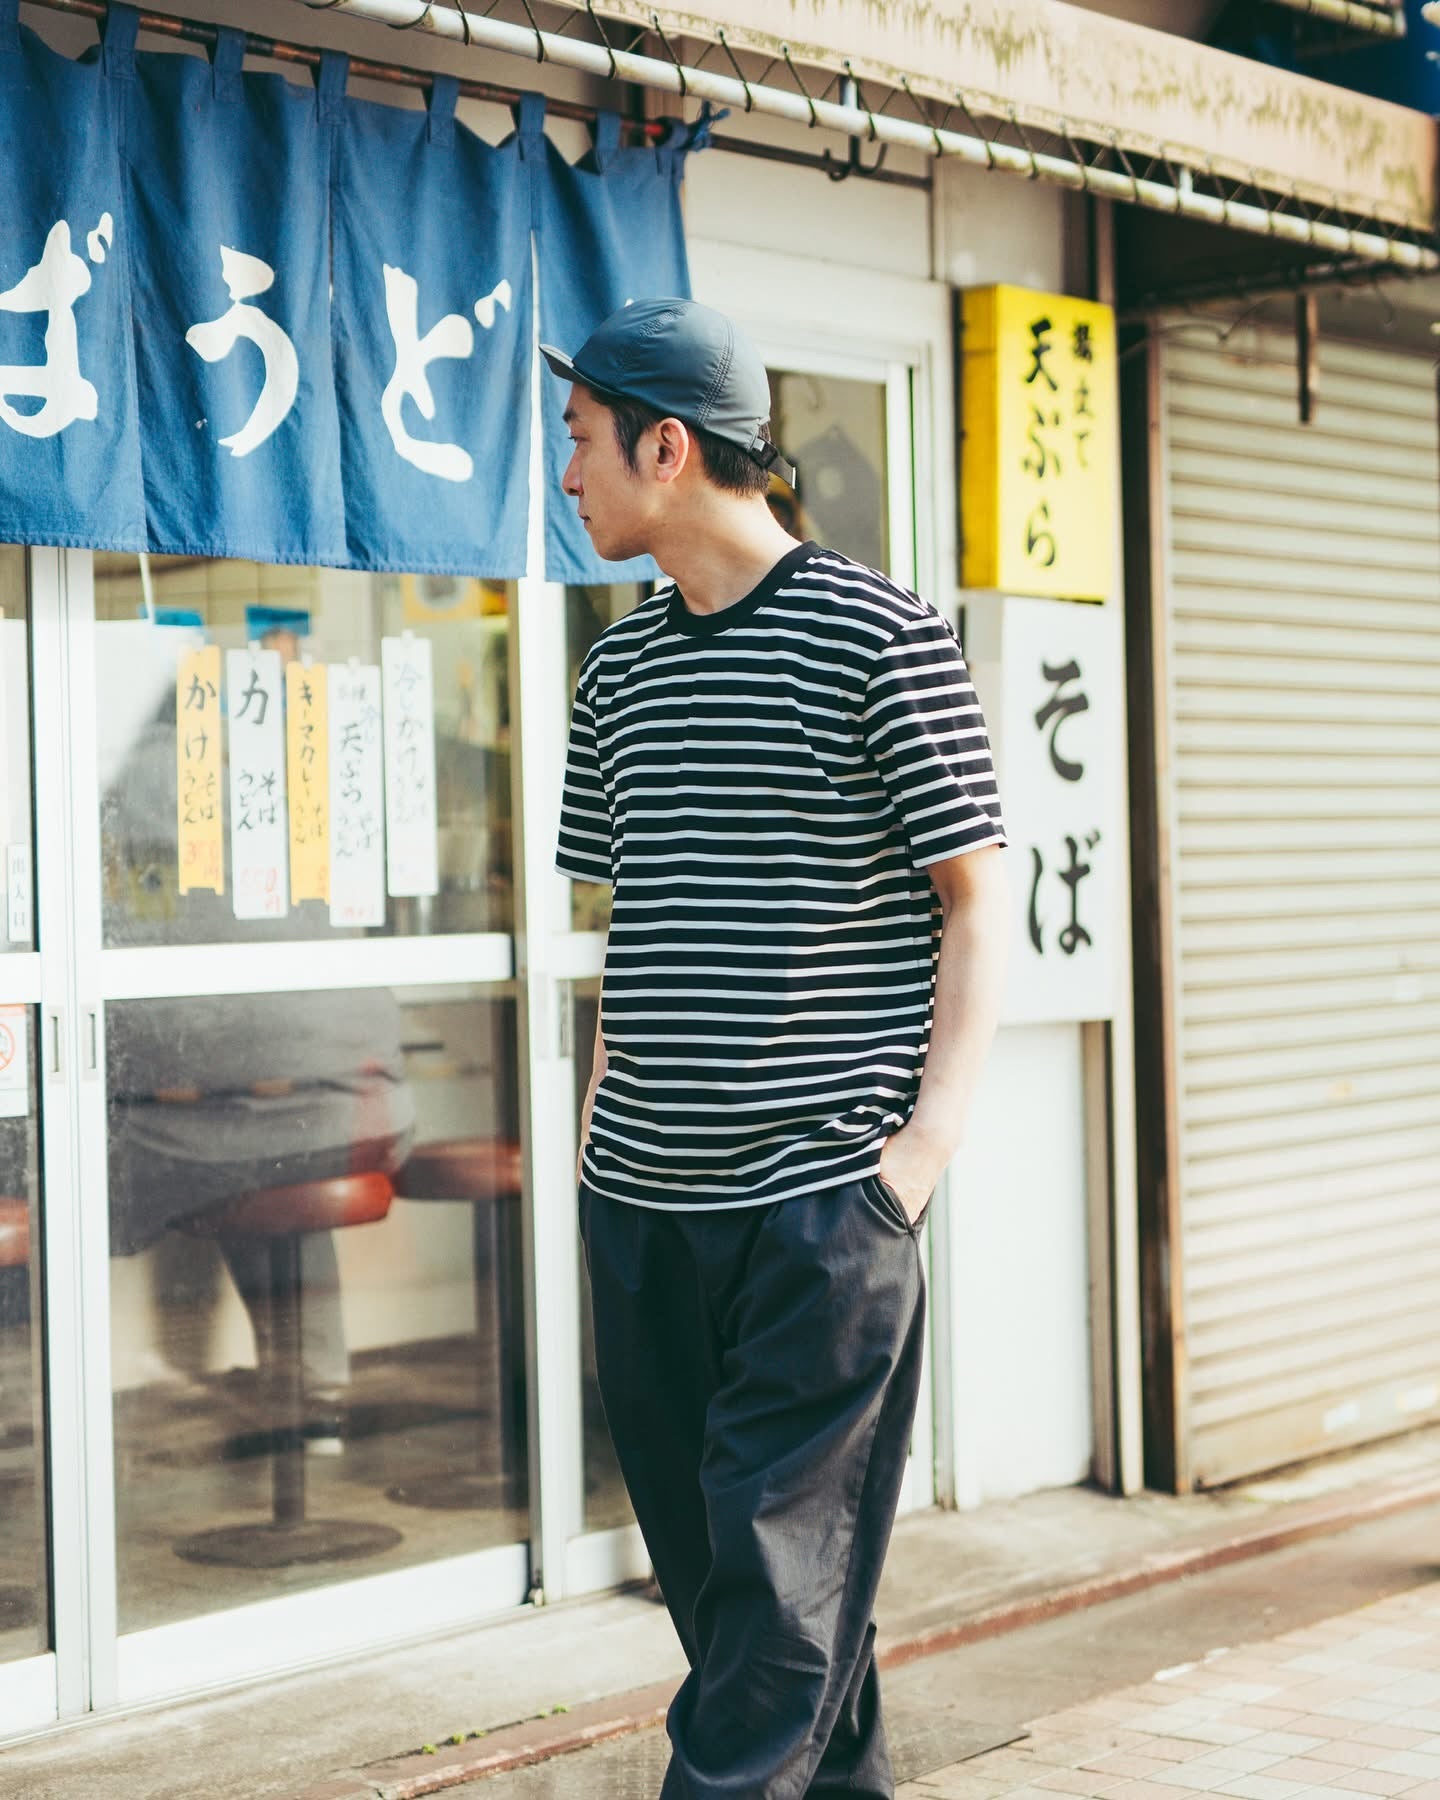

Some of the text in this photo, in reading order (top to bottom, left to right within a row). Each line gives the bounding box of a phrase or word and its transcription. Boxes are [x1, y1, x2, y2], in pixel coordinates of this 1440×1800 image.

[184, 672, 217, 762] かけ
[258, 769, 281, 825] そば
[1028, 656, 1102, 957] そば
